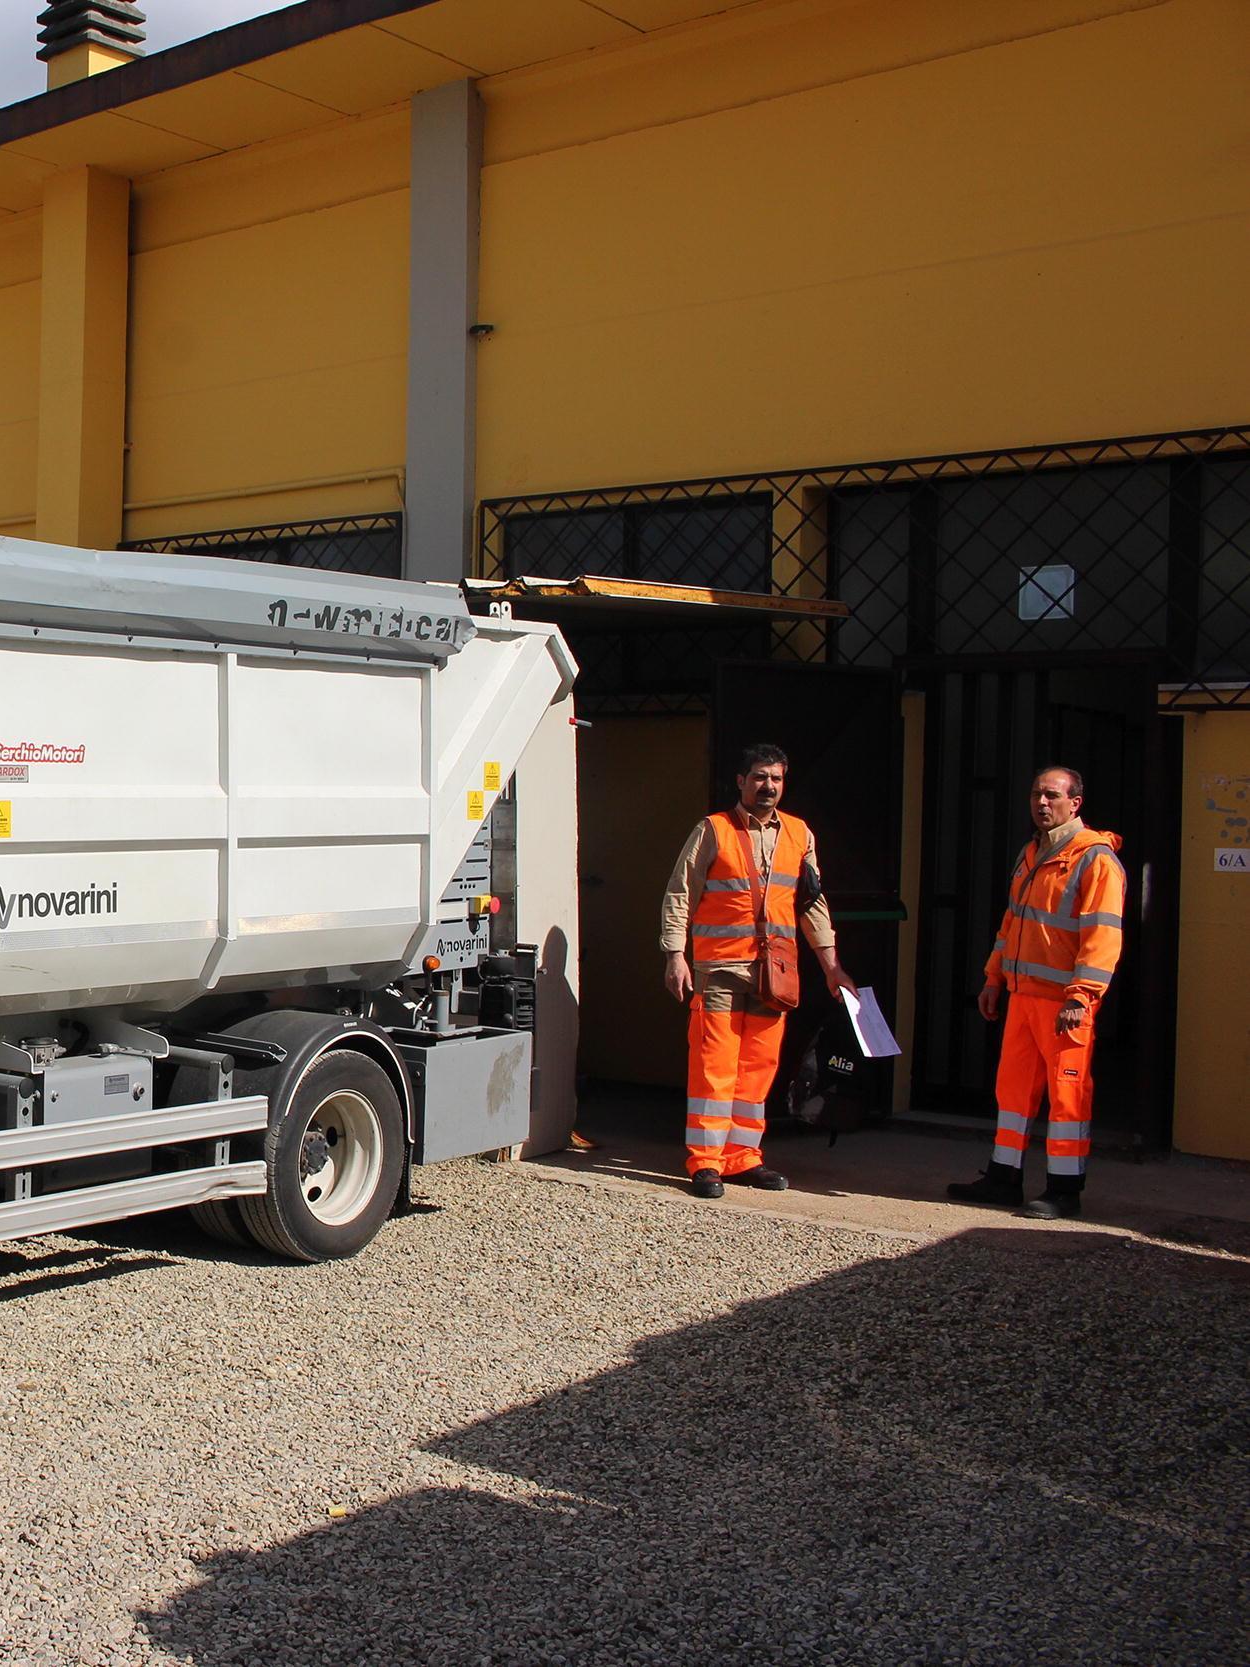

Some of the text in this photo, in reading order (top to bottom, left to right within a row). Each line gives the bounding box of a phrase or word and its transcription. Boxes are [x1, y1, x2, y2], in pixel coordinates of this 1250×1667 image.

[1218, 854, 1246, 867] 6/A
[18, 882, 117, 918] novarini
[447, 934, 488, 952] novarini
[828, 1055, 854, 1071] Alia
